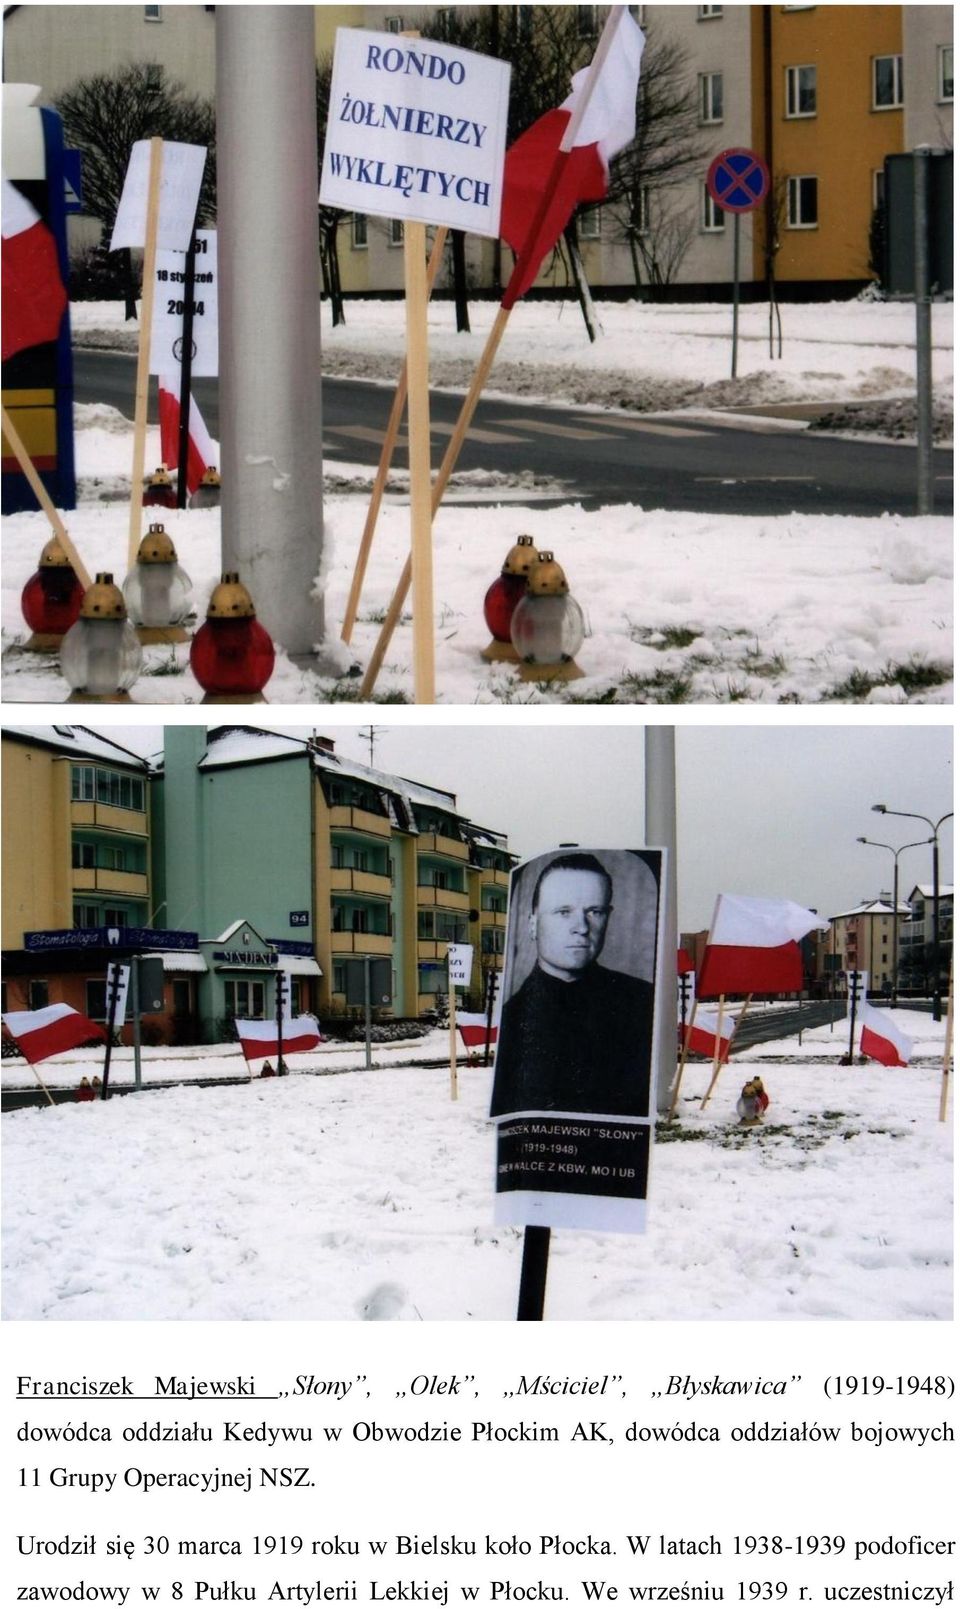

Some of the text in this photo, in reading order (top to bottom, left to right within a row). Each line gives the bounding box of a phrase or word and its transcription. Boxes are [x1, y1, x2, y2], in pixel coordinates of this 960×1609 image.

[365, 45, 466, 86] RONDO
[339, 92, 488, 149] ŻOŁNIERZY
[329, 152, 492, 207] WYKLĘTYCH
[157, 270, 213, 283] 18 styzeń
[291, 914, 307, 923] 94
[29, 931, 98, 947] Stomatologia
[531, 1124, 590, 1137] MAJEWSKI
[594, 1128, 643, 1140] "SŁONY"
[521, 1143, 578, 1156] (1919-1948)
[547, 1162, 555, 1172] Z
[591, 1166, 610, 1176] MO
[619, 1168, 636, 1178] UB
[17, 1375, 954, 1400] Franciszek Majewski „Słony”, „Olek”, „Mściciel”, „Błyskawica” (1919-1948)
[17, 1422, 954, 1446] dowódca oddziału Kedywu w Obwodzie Płockim AK, dowódca oddziałów bojowych
[19, 1468, 315, 1492] 11 Grupy Operacyjnej NSZ.
[17, 1535, 956, 1560] Urodził się 30 marca 1919 roku w Bielsku koło Płocka. W latach 1938-1939 podoficer
[17, 1581, 954, 1605] zawodowy w 8 Pułku Artylerii Lekkiej w Płocku. We wrześniu 1939 r. uczestniczył
